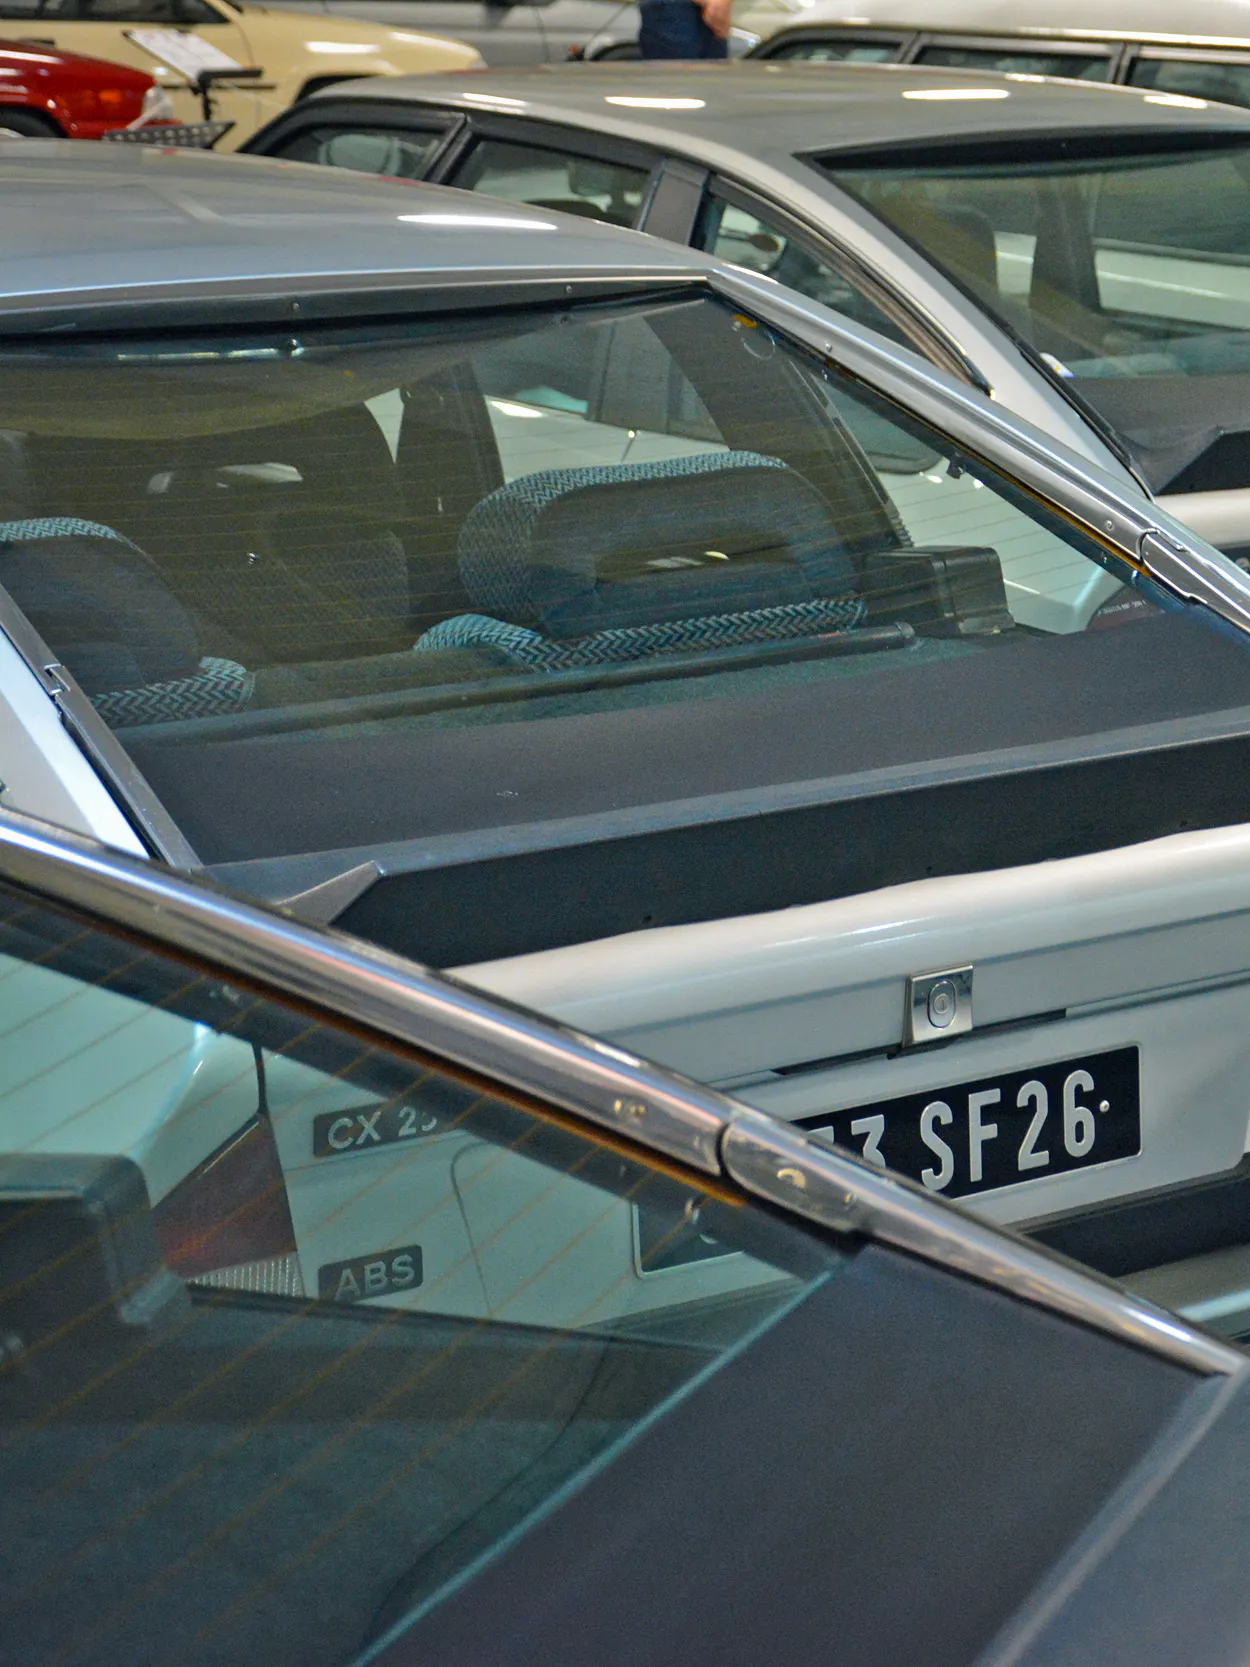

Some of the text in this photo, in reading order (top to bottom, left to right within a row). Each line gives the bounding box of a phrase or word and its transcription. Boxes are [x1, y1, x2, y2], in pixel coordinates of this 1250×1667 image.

[328, 1111, 382, 1149] CX
[806, 1114, 887, 1169] 3
[335, 1254, 415, 1301] ABS
